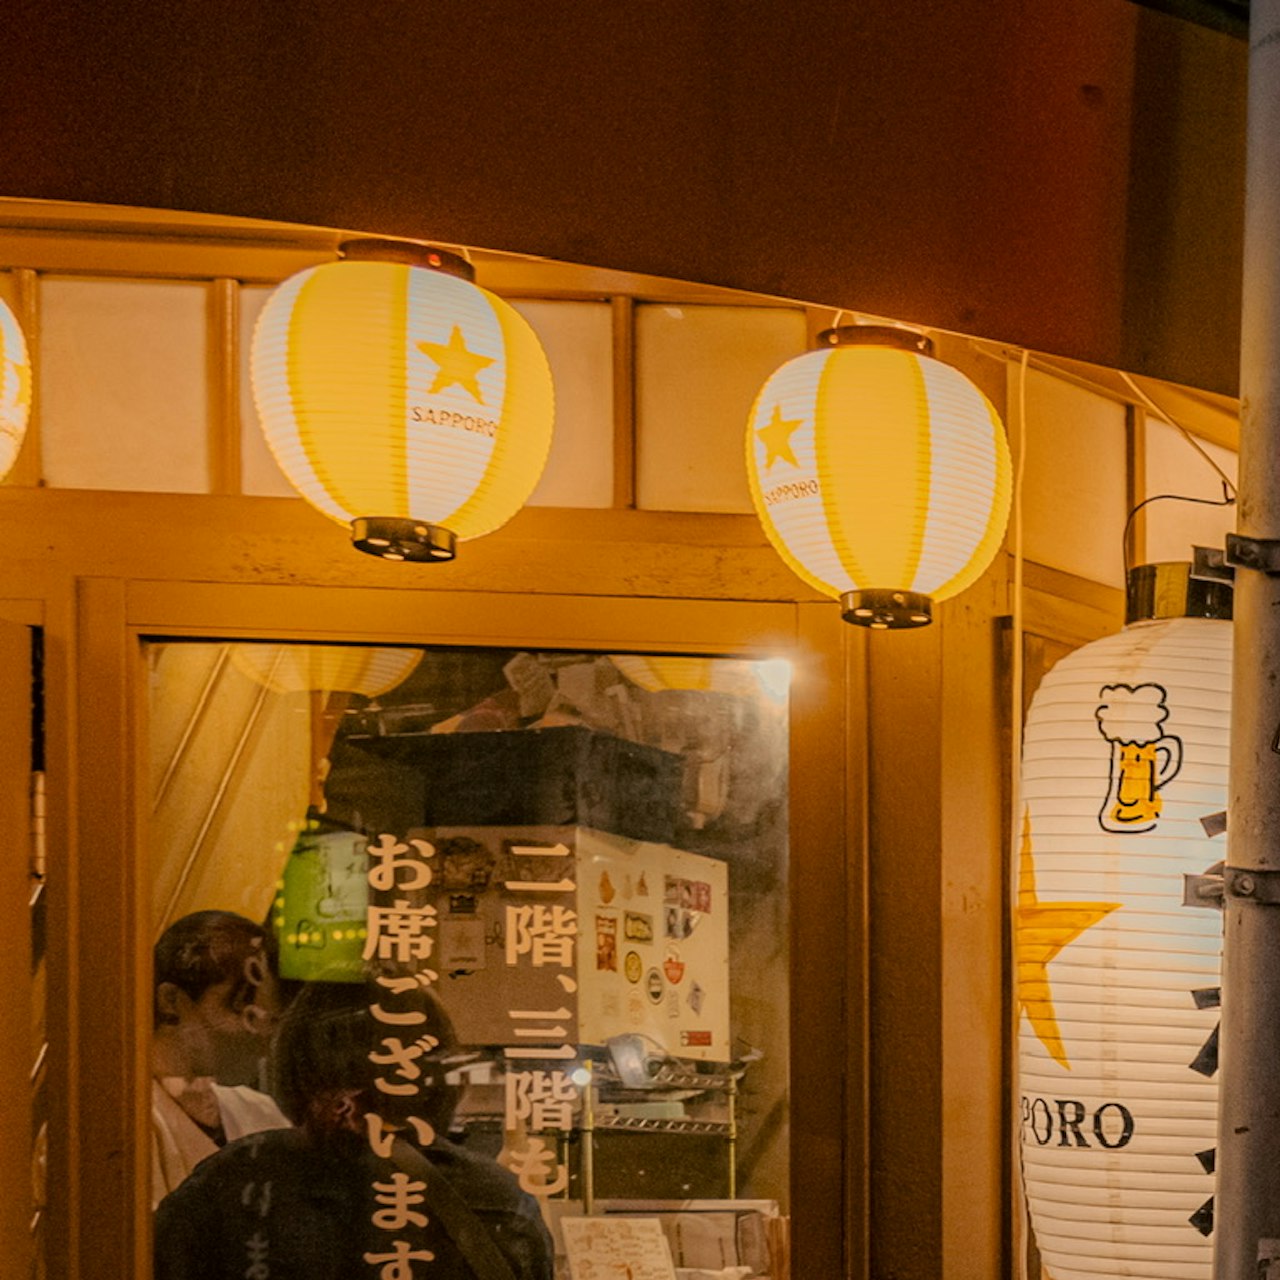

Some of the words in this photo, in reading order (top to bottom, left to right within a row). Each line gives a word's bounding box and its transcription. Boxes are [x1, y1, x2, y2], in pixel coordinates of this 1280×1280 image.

[410, 403, 500, 439] SAPPORO
[764, 477, 822, 505] SAPPORO
[504, 842, 579, 1198] 二階、三階も
